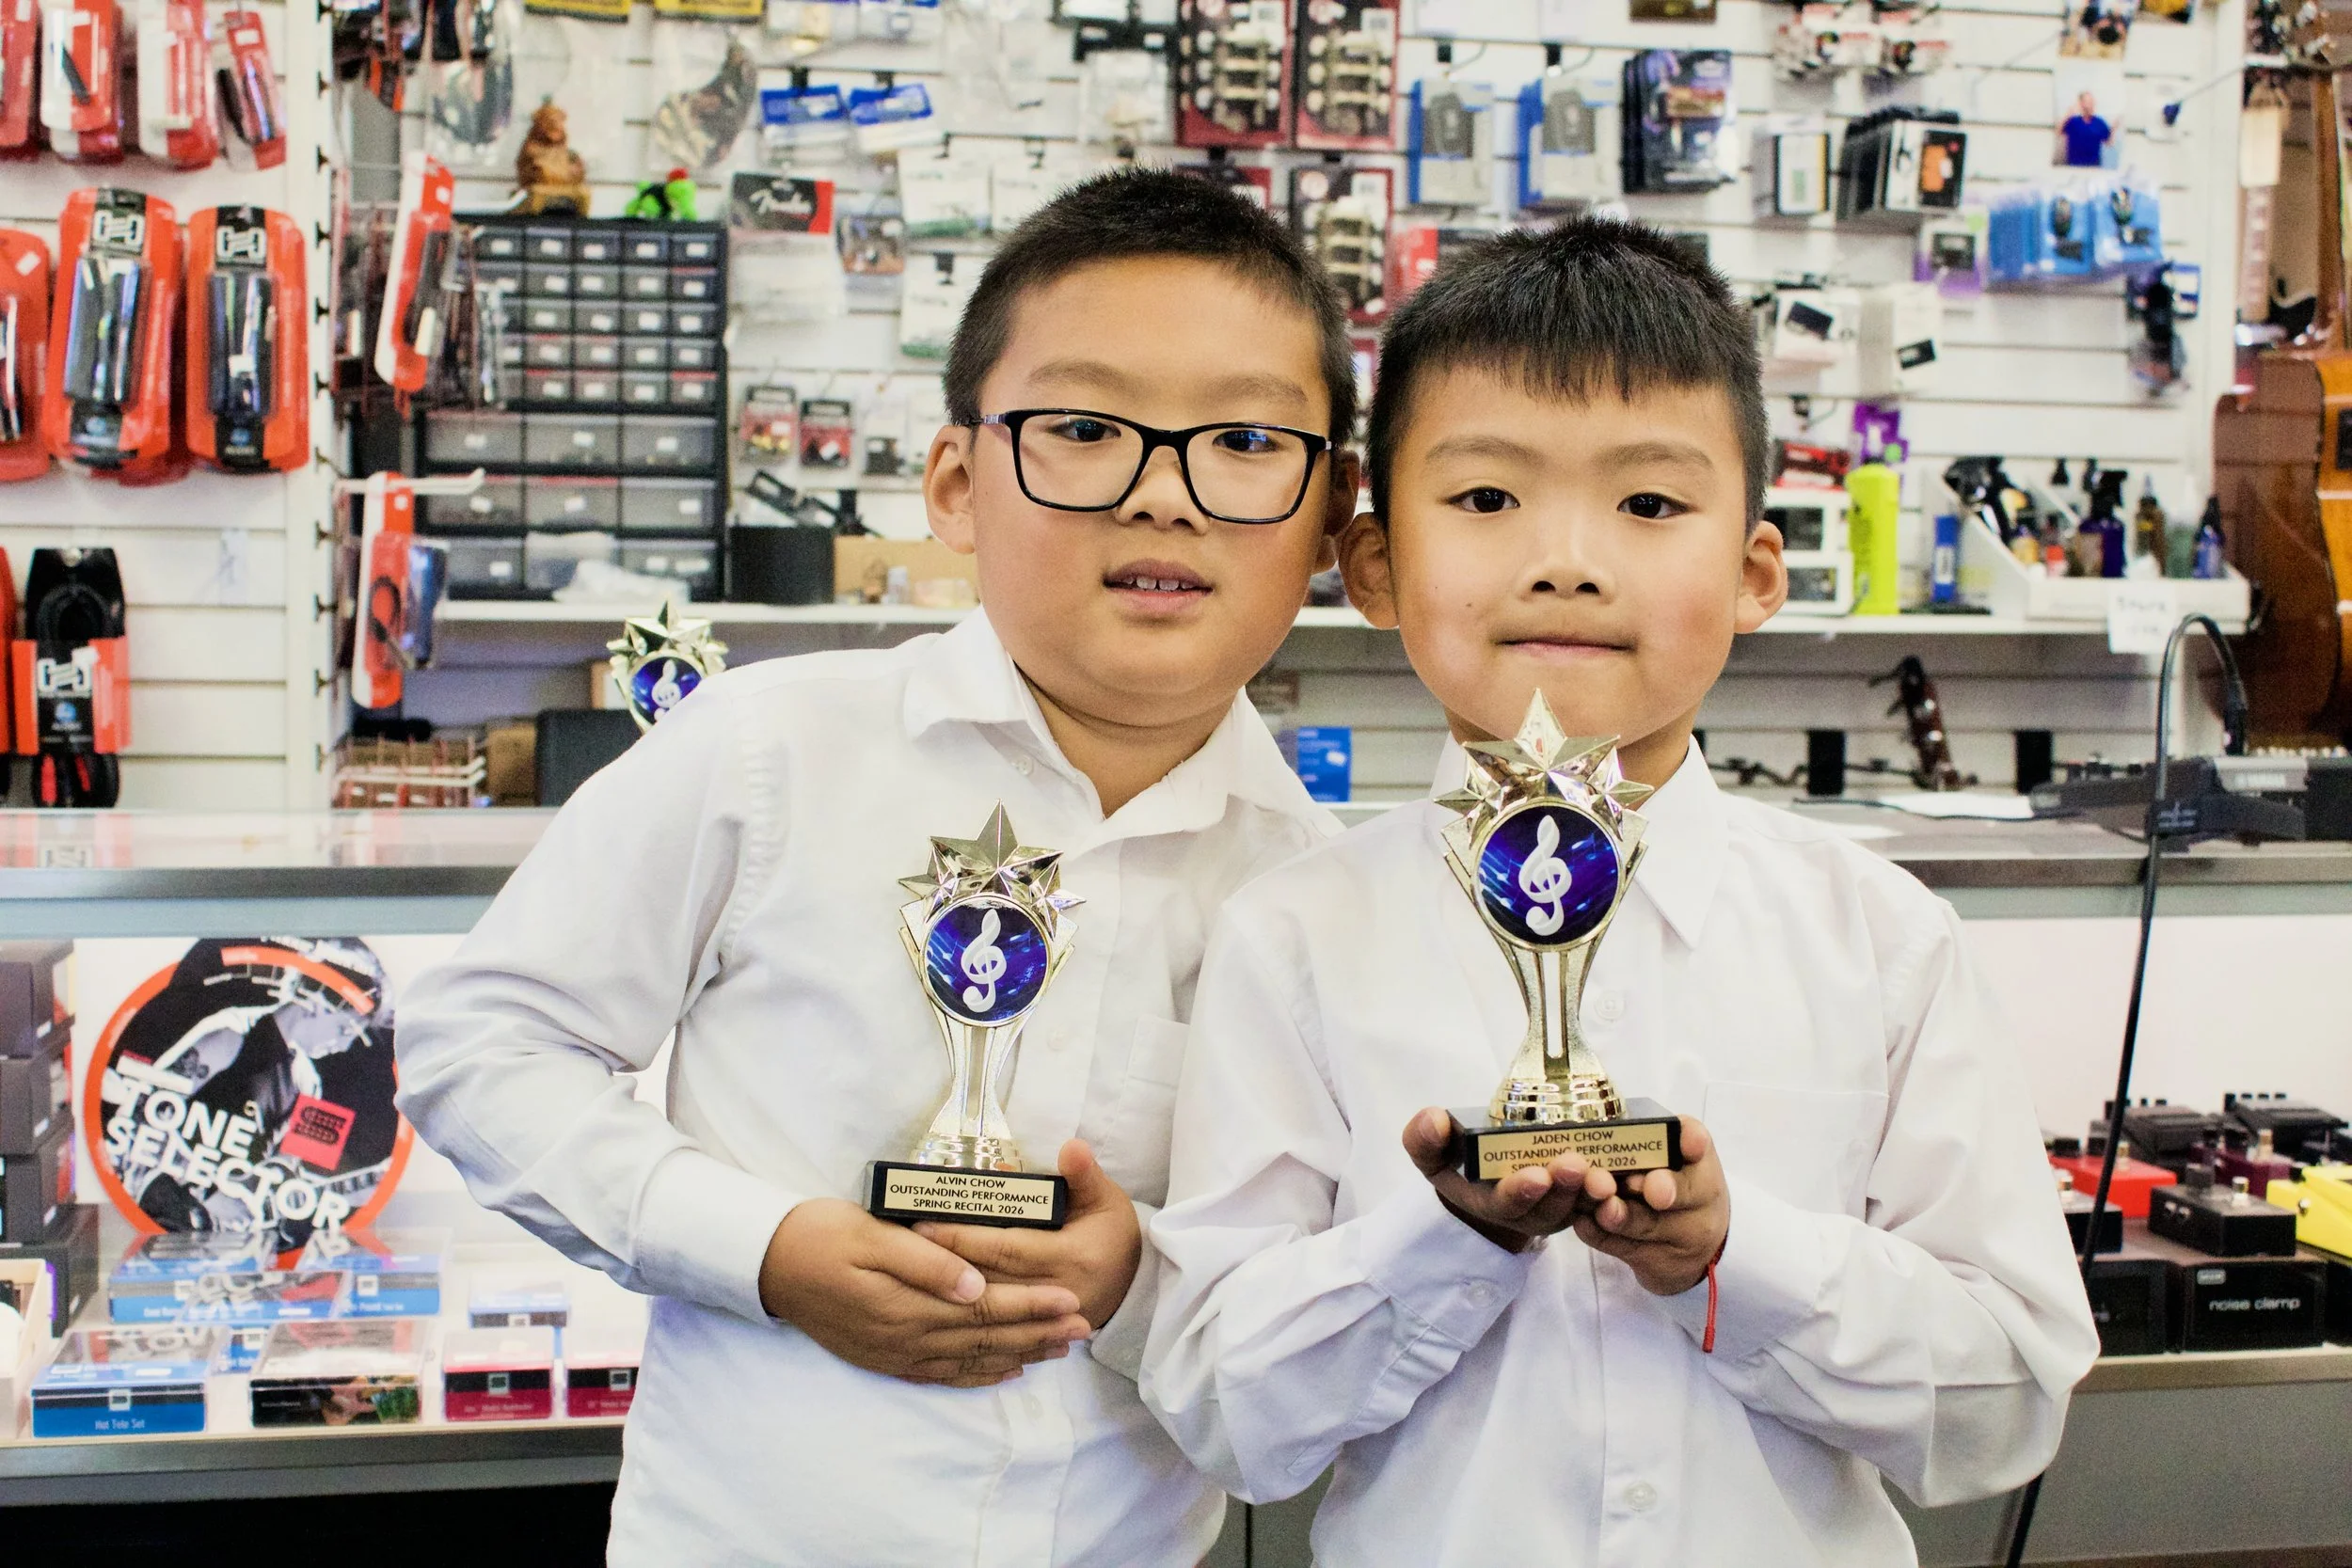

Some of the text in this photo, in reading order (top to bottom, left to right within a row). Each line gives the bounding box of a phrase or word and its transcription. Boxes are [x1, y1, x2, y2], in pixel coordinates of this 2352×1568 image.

[120, 1075, 258, 1159] TONE
[1532, 1131, 1613, 1146] JADEN CHOW
[1576, 1140, 1663, 1156] PERFORMANCE
[1607, 1156, 1637, 1167] 2026
[104, 1117, 351, 1231] SELECTOR
[935, 1176, 1006, 1189] ALVIN CHOW
[890, 1184, 1049, 1205] OUTSTANDING PERFORMANCE
[913, 1198, 1025, 1215] SPRING RECITAL 2026
[2208, 1299, 2250, 1311] noise
